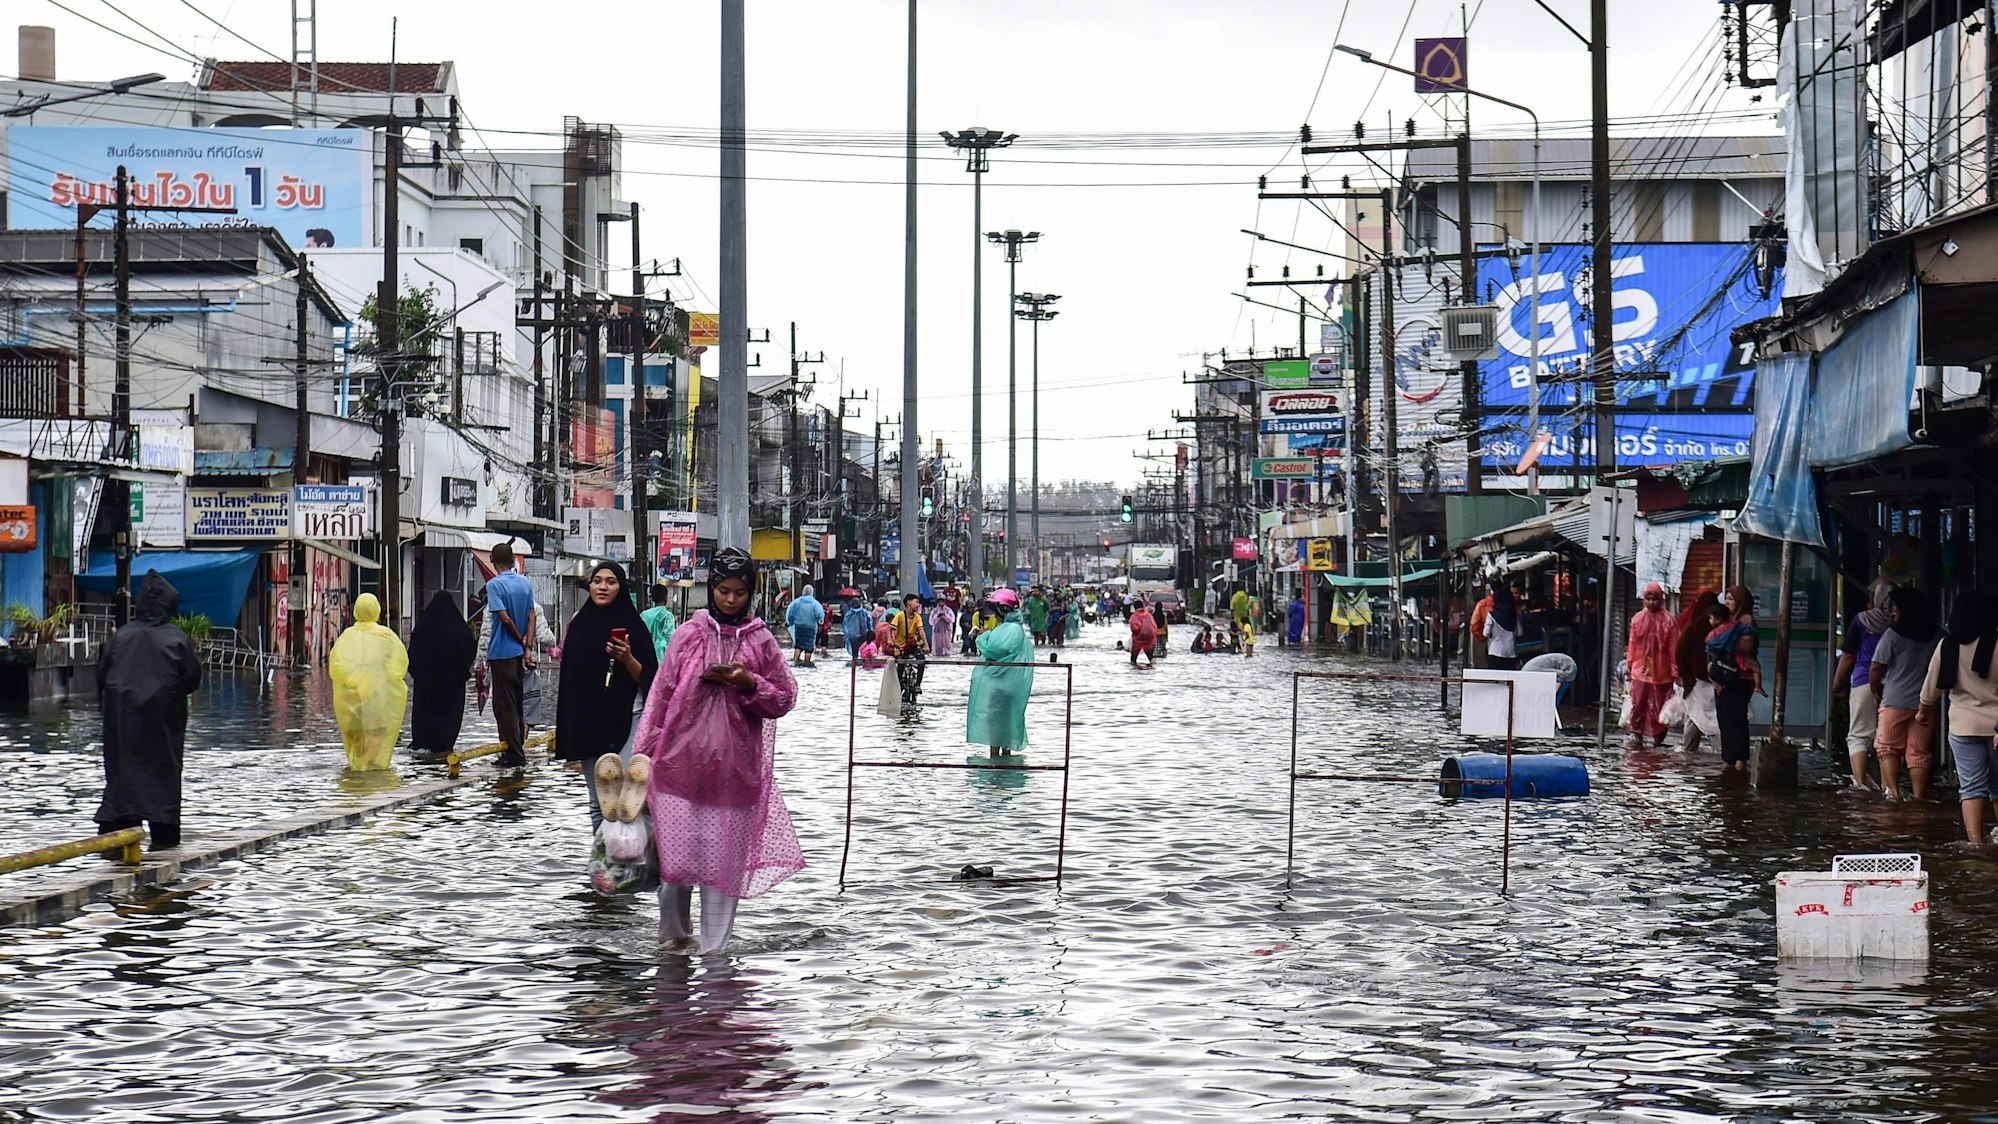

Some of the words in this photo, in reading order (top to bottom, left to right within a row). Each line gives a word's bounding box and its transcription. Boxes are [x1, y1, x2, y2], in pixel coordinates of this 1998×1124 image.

[107, 143, 203, 158] สินเชื่อรถแลกเงิน
[206, 145, 264, 159] ทีทีบีไดรฟ์
[245, 167, 262, 205] 1
[276, 176, 321, 206] วัน
[1496, 256, 1659, 358] GS
[1508, 339, 1658, 389] BATTRY
[1664, 439, 1705, 456] จำกัด
[1735, 444, 1750, 456] 0
[1273, 463, 1307, 473] Castrol
[299, 486, 325, 500] ไม้อัด
[328, 488, 360, 500] ตาข่าย
